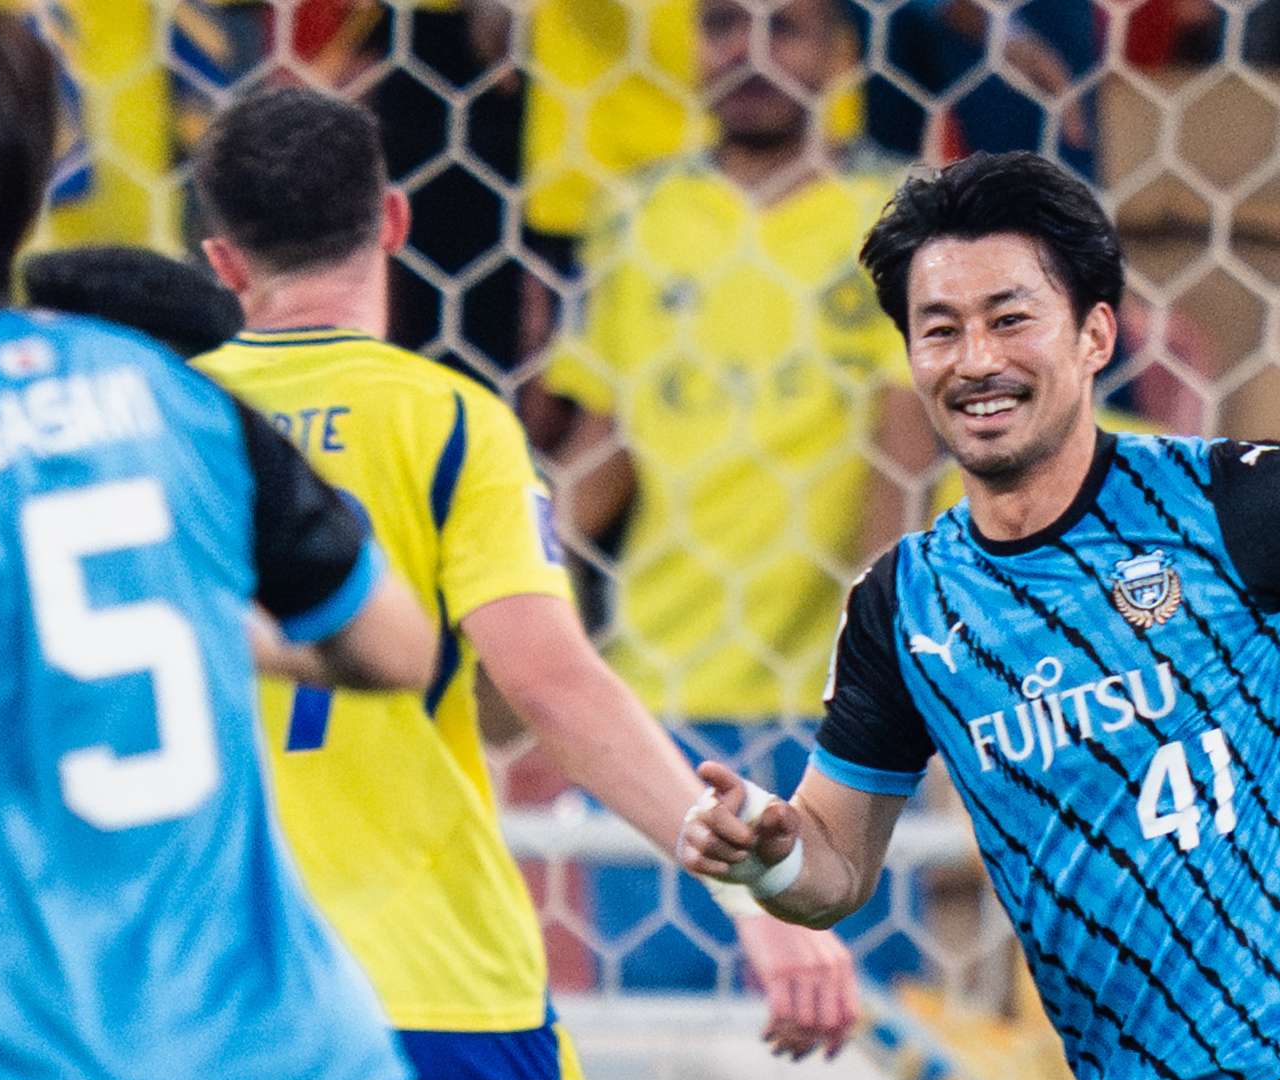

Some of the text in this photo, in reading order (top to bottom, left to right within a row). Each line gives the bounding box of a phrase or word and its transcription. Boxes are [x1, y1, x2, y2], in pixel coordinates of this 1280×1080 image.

[24, 478, 220, 830] 5
[969, 661, 1177, 773] FUJITSU
[1136, 728, 1236, 850] 41
